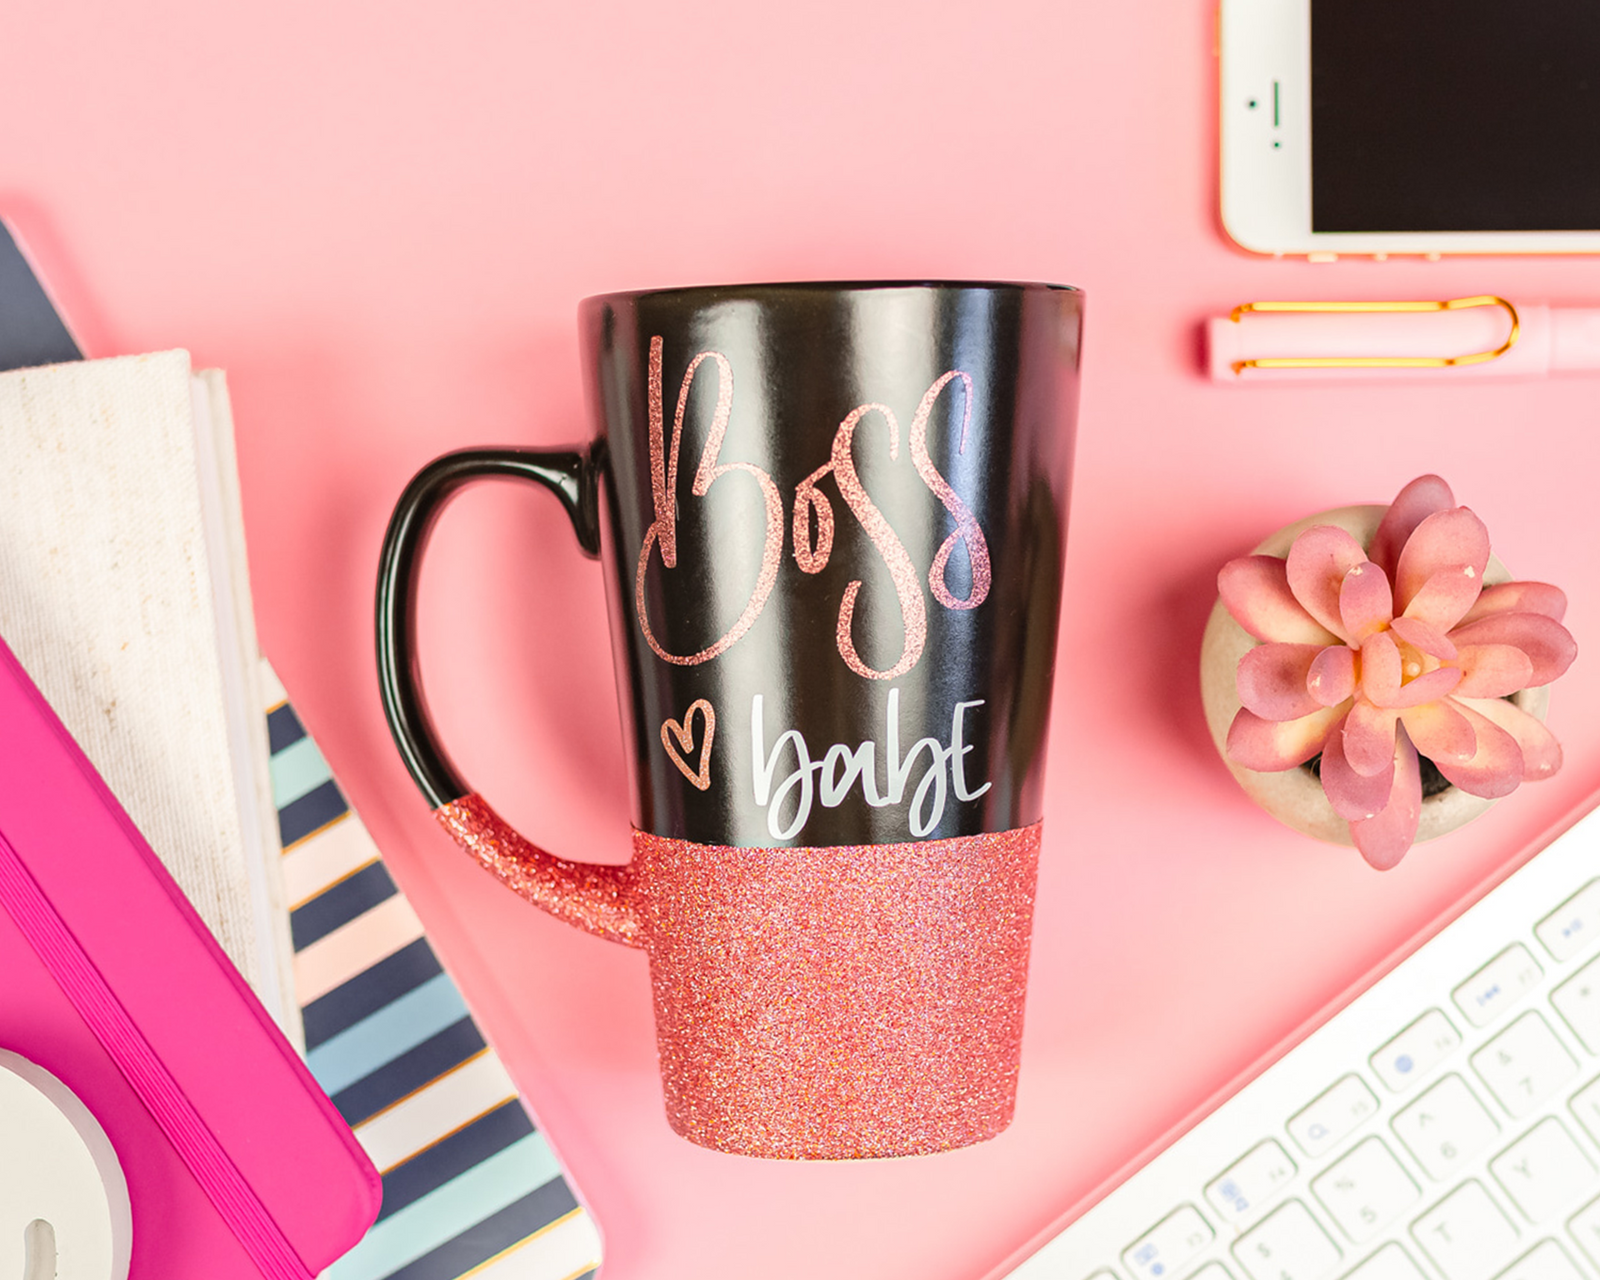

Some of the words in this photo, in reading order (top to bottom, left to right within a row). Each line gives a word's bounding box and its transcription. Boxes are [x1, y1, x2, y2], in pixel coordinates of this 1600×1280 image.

[1518, 1076, 1534, 1096] 7
[1440, 1141, 1457, 1160] 6
[1511, 1157, 1532, 1179] Y
[1360, 1204, 1377, 1224] 5
[1432, 1220, 1452, 1243] T
